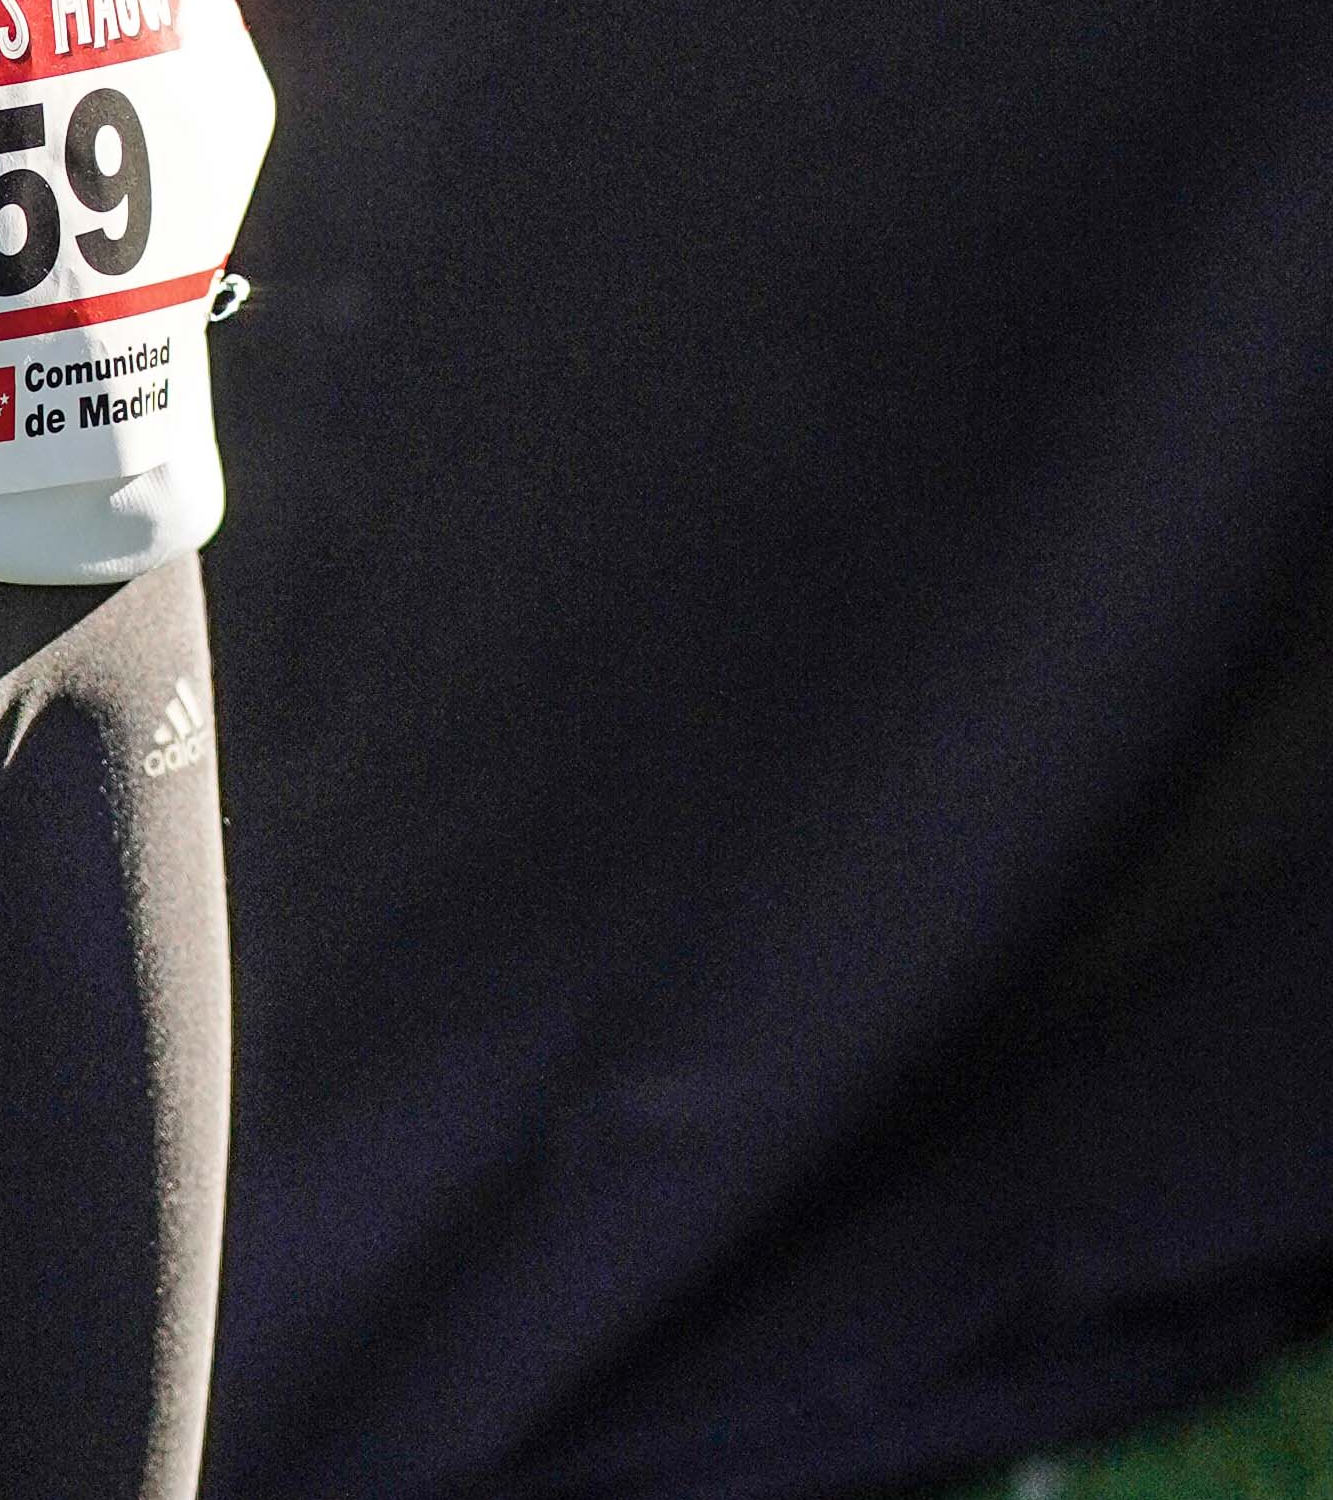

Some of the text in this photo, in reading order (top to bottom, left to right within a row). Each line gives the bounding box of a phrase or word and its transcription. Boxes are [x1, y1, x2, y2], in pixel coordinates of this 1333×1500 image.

[24, 336, 171, 393] Comunidad
[24, 378, 169, 438] de Madrid
